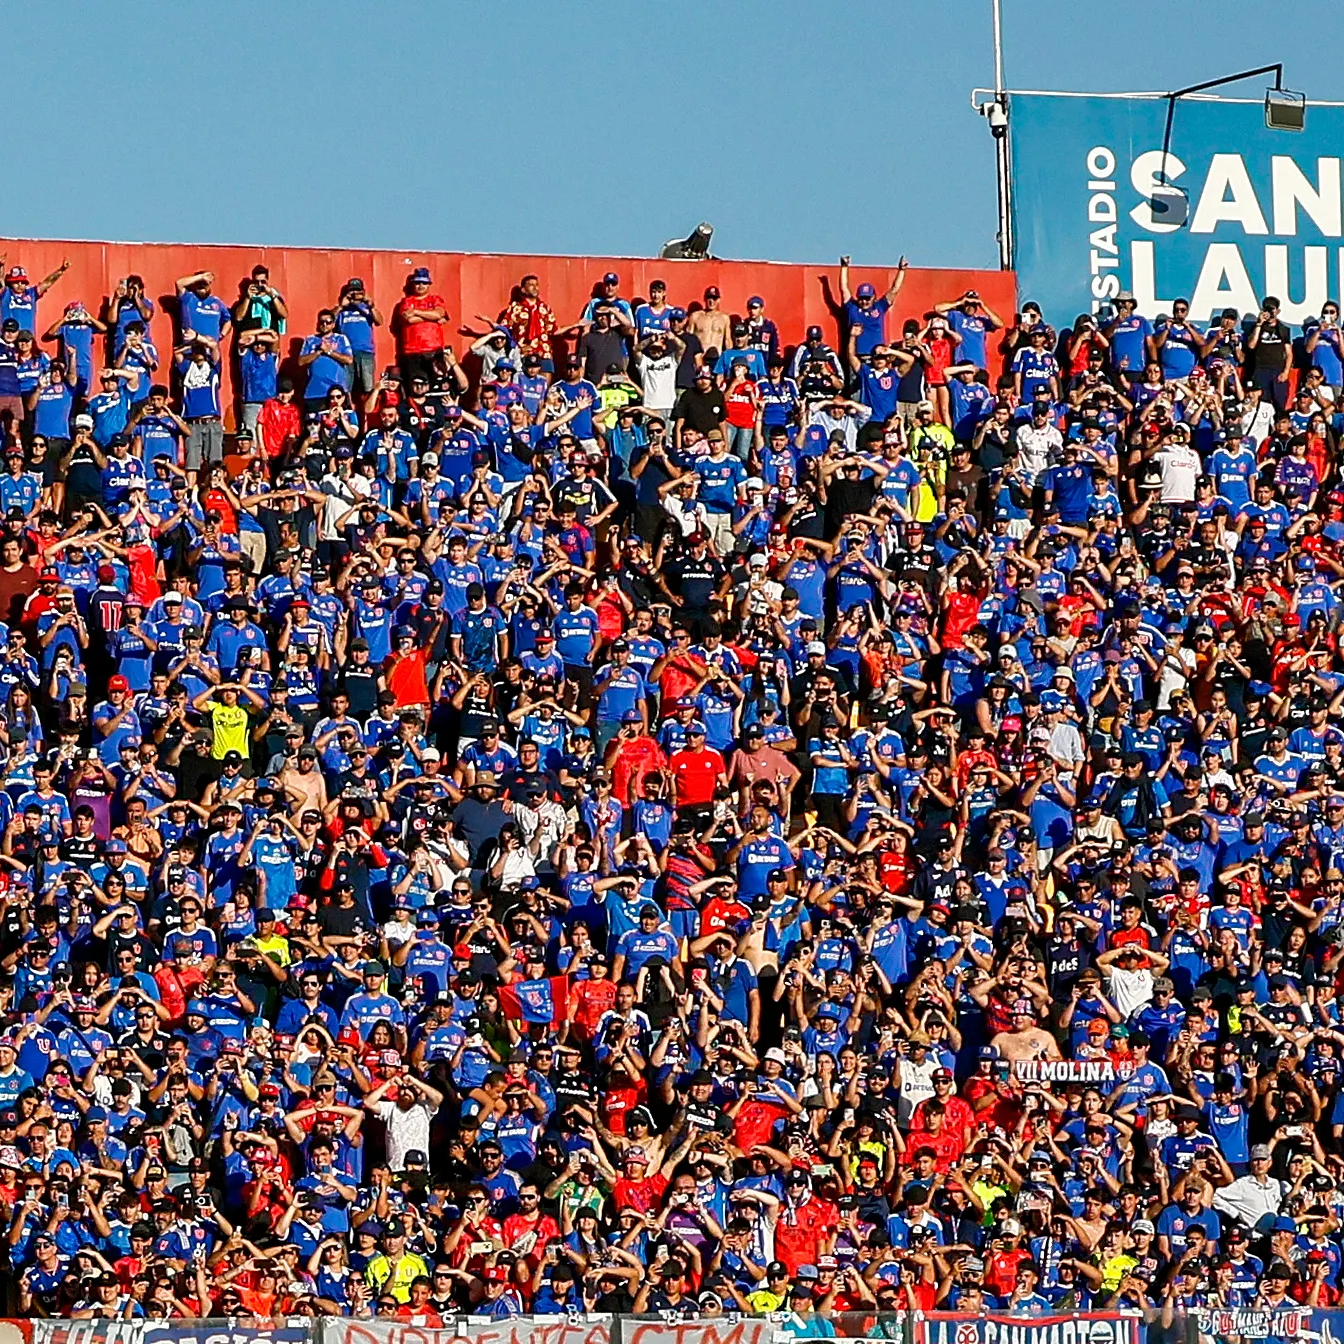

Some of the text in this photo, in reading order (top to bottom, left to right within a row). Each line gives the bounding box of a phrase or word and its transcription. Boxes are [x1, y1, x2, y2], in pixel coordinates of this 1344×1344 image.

[1026, 369, 1054, 378] Claro
[1171, 460, 1196, 469] Claro
[100, 601, 122, 631] 11
[1052, 958, 1078, 973] AdeS
[1041, 1062, 1115, 1081] MOLINA
